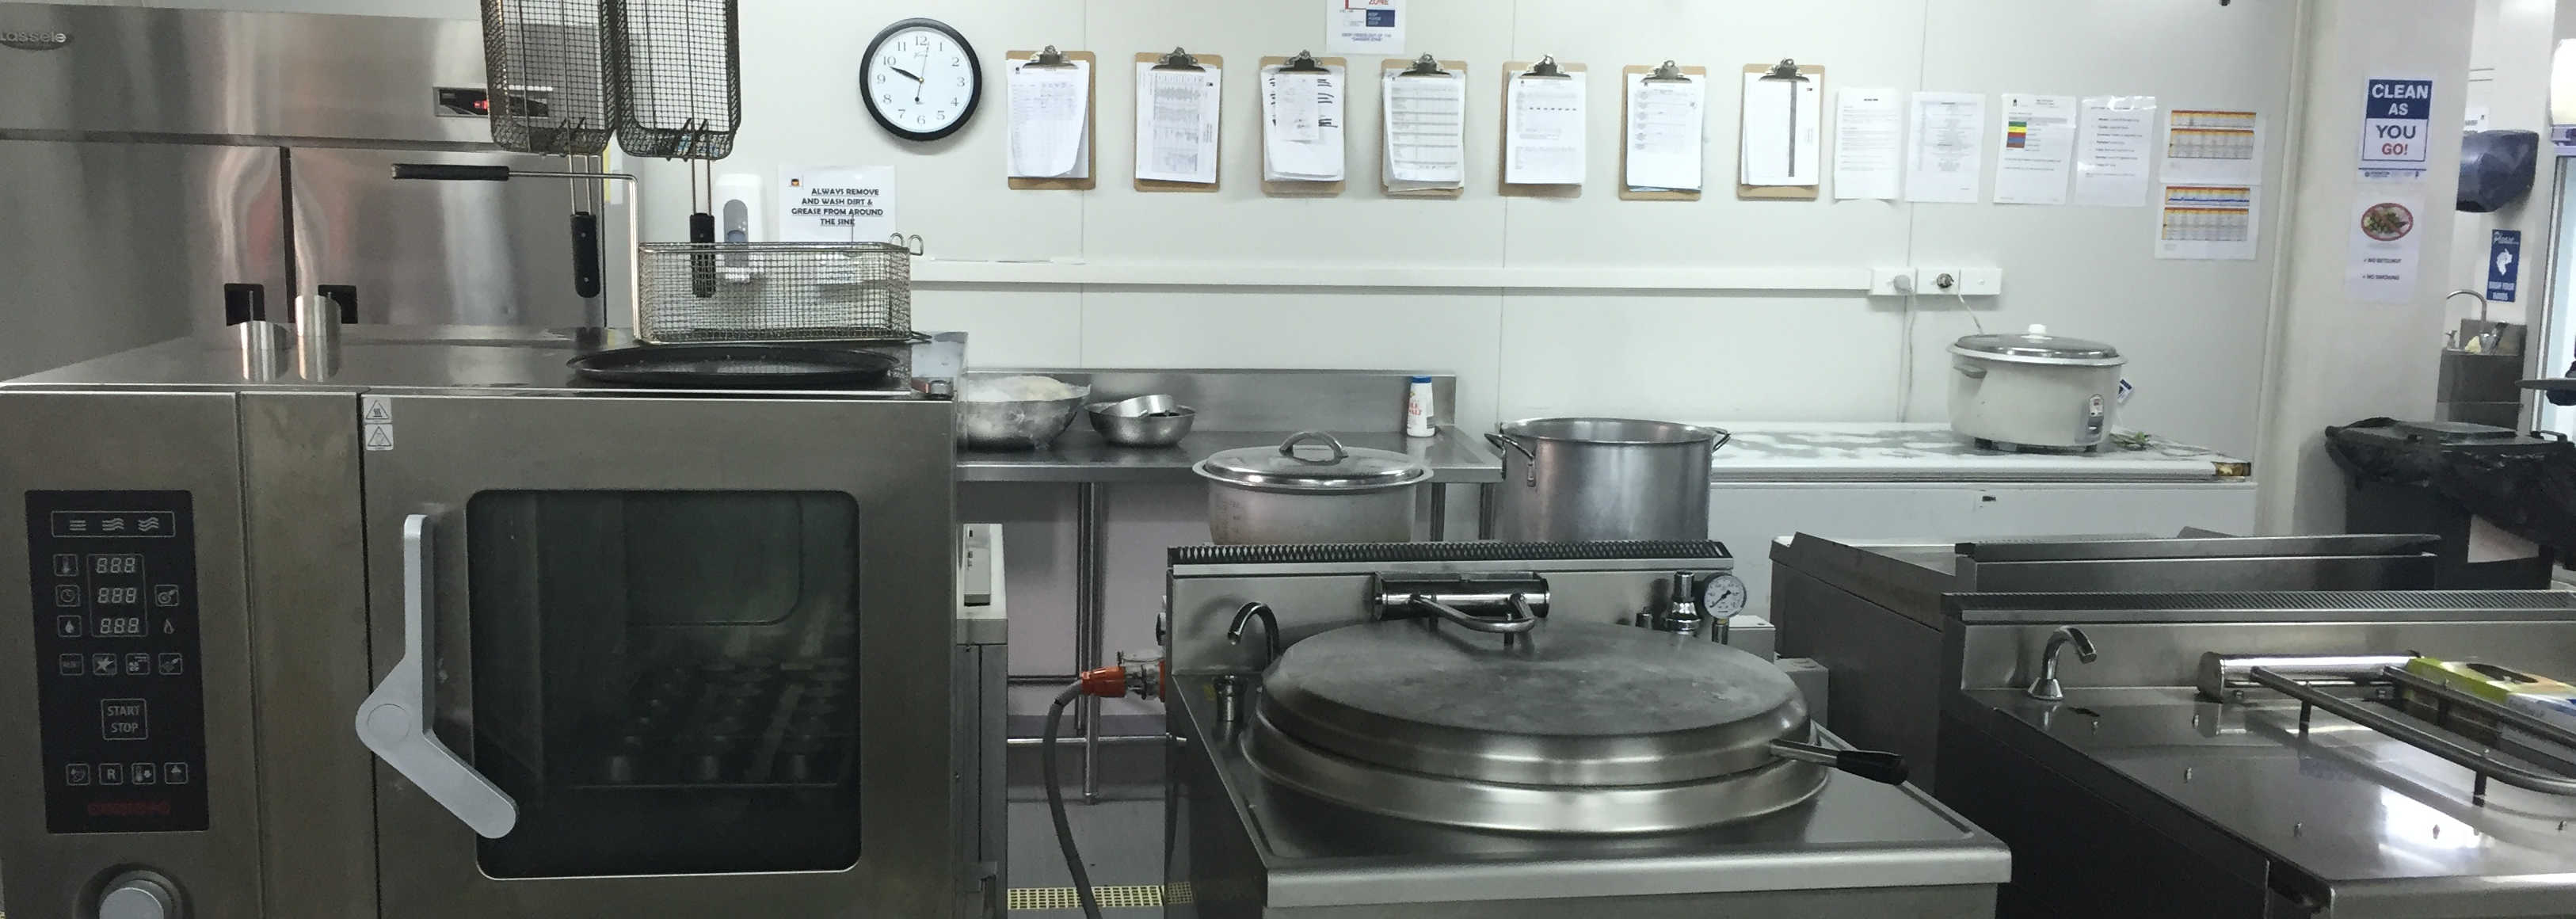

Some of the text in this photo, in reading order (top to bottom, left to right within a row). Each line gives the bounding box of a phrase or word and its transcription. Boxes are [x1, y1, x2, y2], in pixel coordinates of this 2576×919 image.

[897, 41, 906, 51] 11
[915, 36, 928, 46] 12
[883, 56, 897, 66] 10
[951, 56, 959, 67] 2
[877, 74, 886, 84] 9
[956, 77, 965, 87] 3
[2372, 83, 2429, 99] CLEAN
[882, 94, 892, 105] 8
[951, 97, 959, 107] 4
[897, 109, 905, 119] 7
[2388, 103, 2409, 116] AS
[917, 115, 926, 124] 6
[936, 110, 945, 120] 5
[2376, 124, 2417, 139] YOU
[2382, 143, 2408, 155] GO!
[107, 705, 140, 716] START
[110, 722, 139, 733] STOP
[107, 768, 116, 780] R
